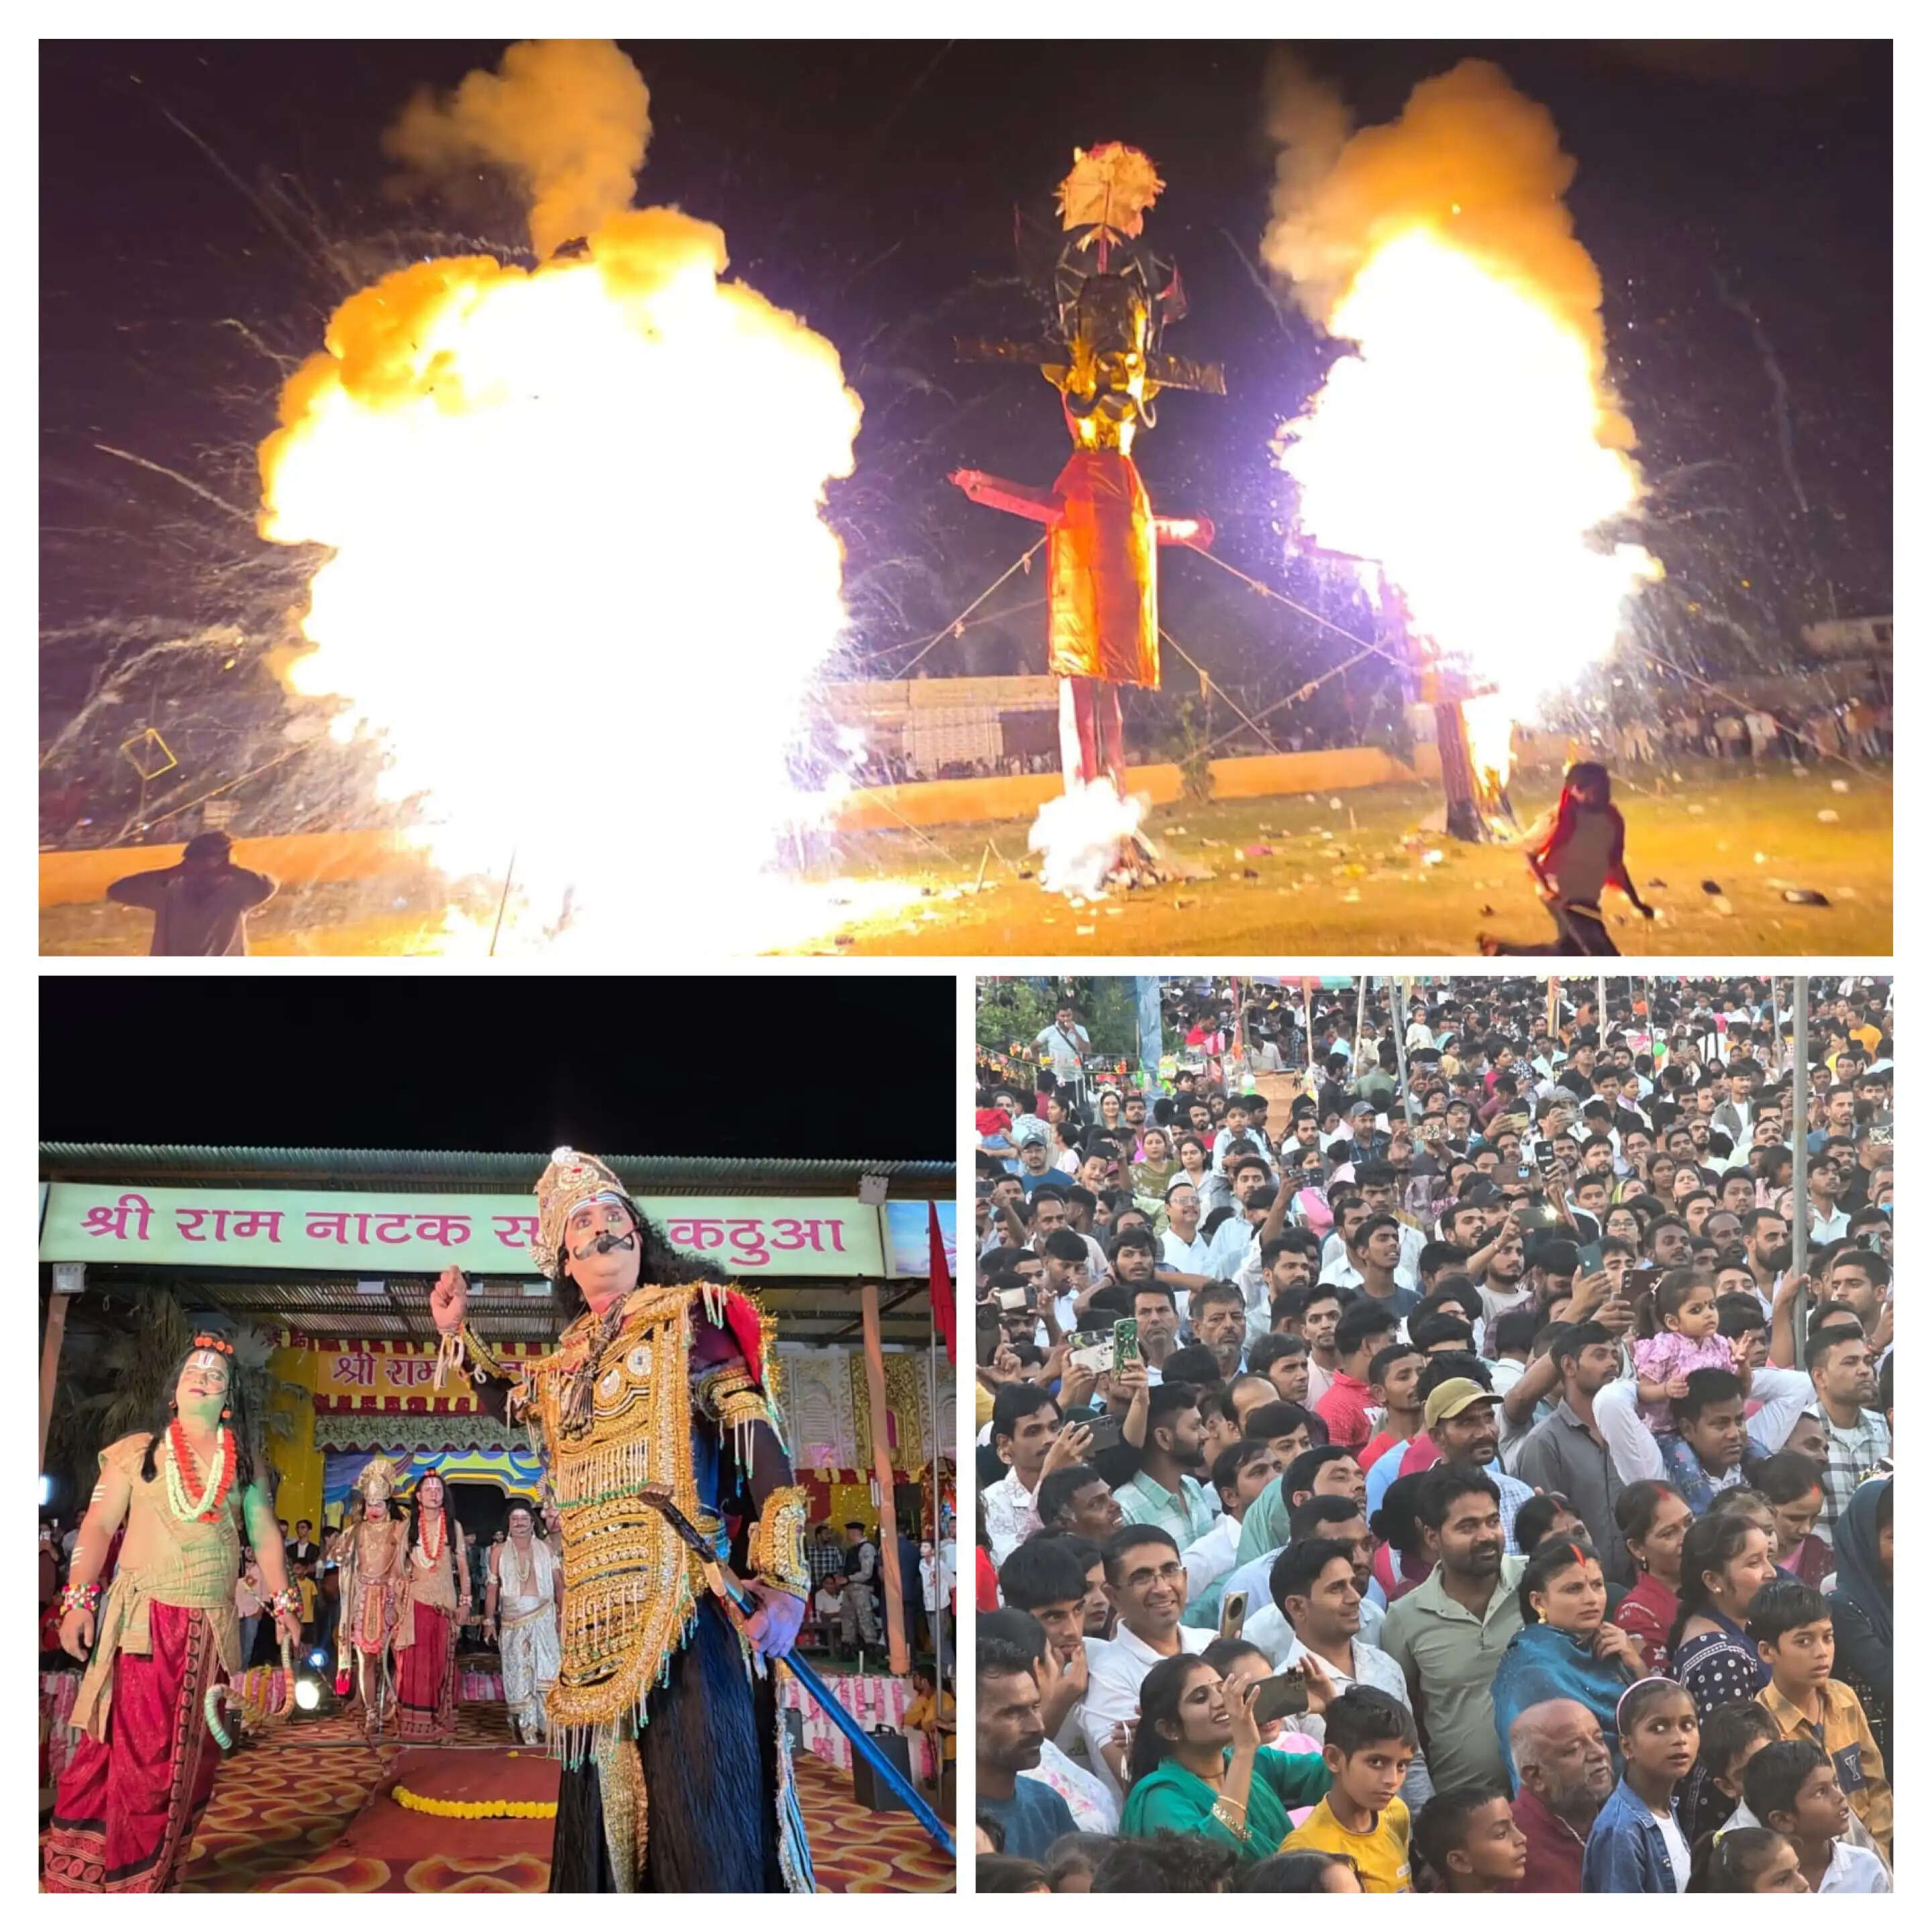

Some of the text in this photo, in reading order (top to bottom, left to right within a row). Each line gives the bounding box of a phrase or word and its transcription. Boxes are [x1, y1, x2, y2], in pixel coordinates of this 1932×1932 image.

[81, 1194, 154, 1240] श्री
[176, 1208, 284, 1242] राम
[306, 1212, 472, 1246] नाटक
[667, 1219, 847, 1265] कठुआ
[333, 1352, 447, 1388] श्री राम
